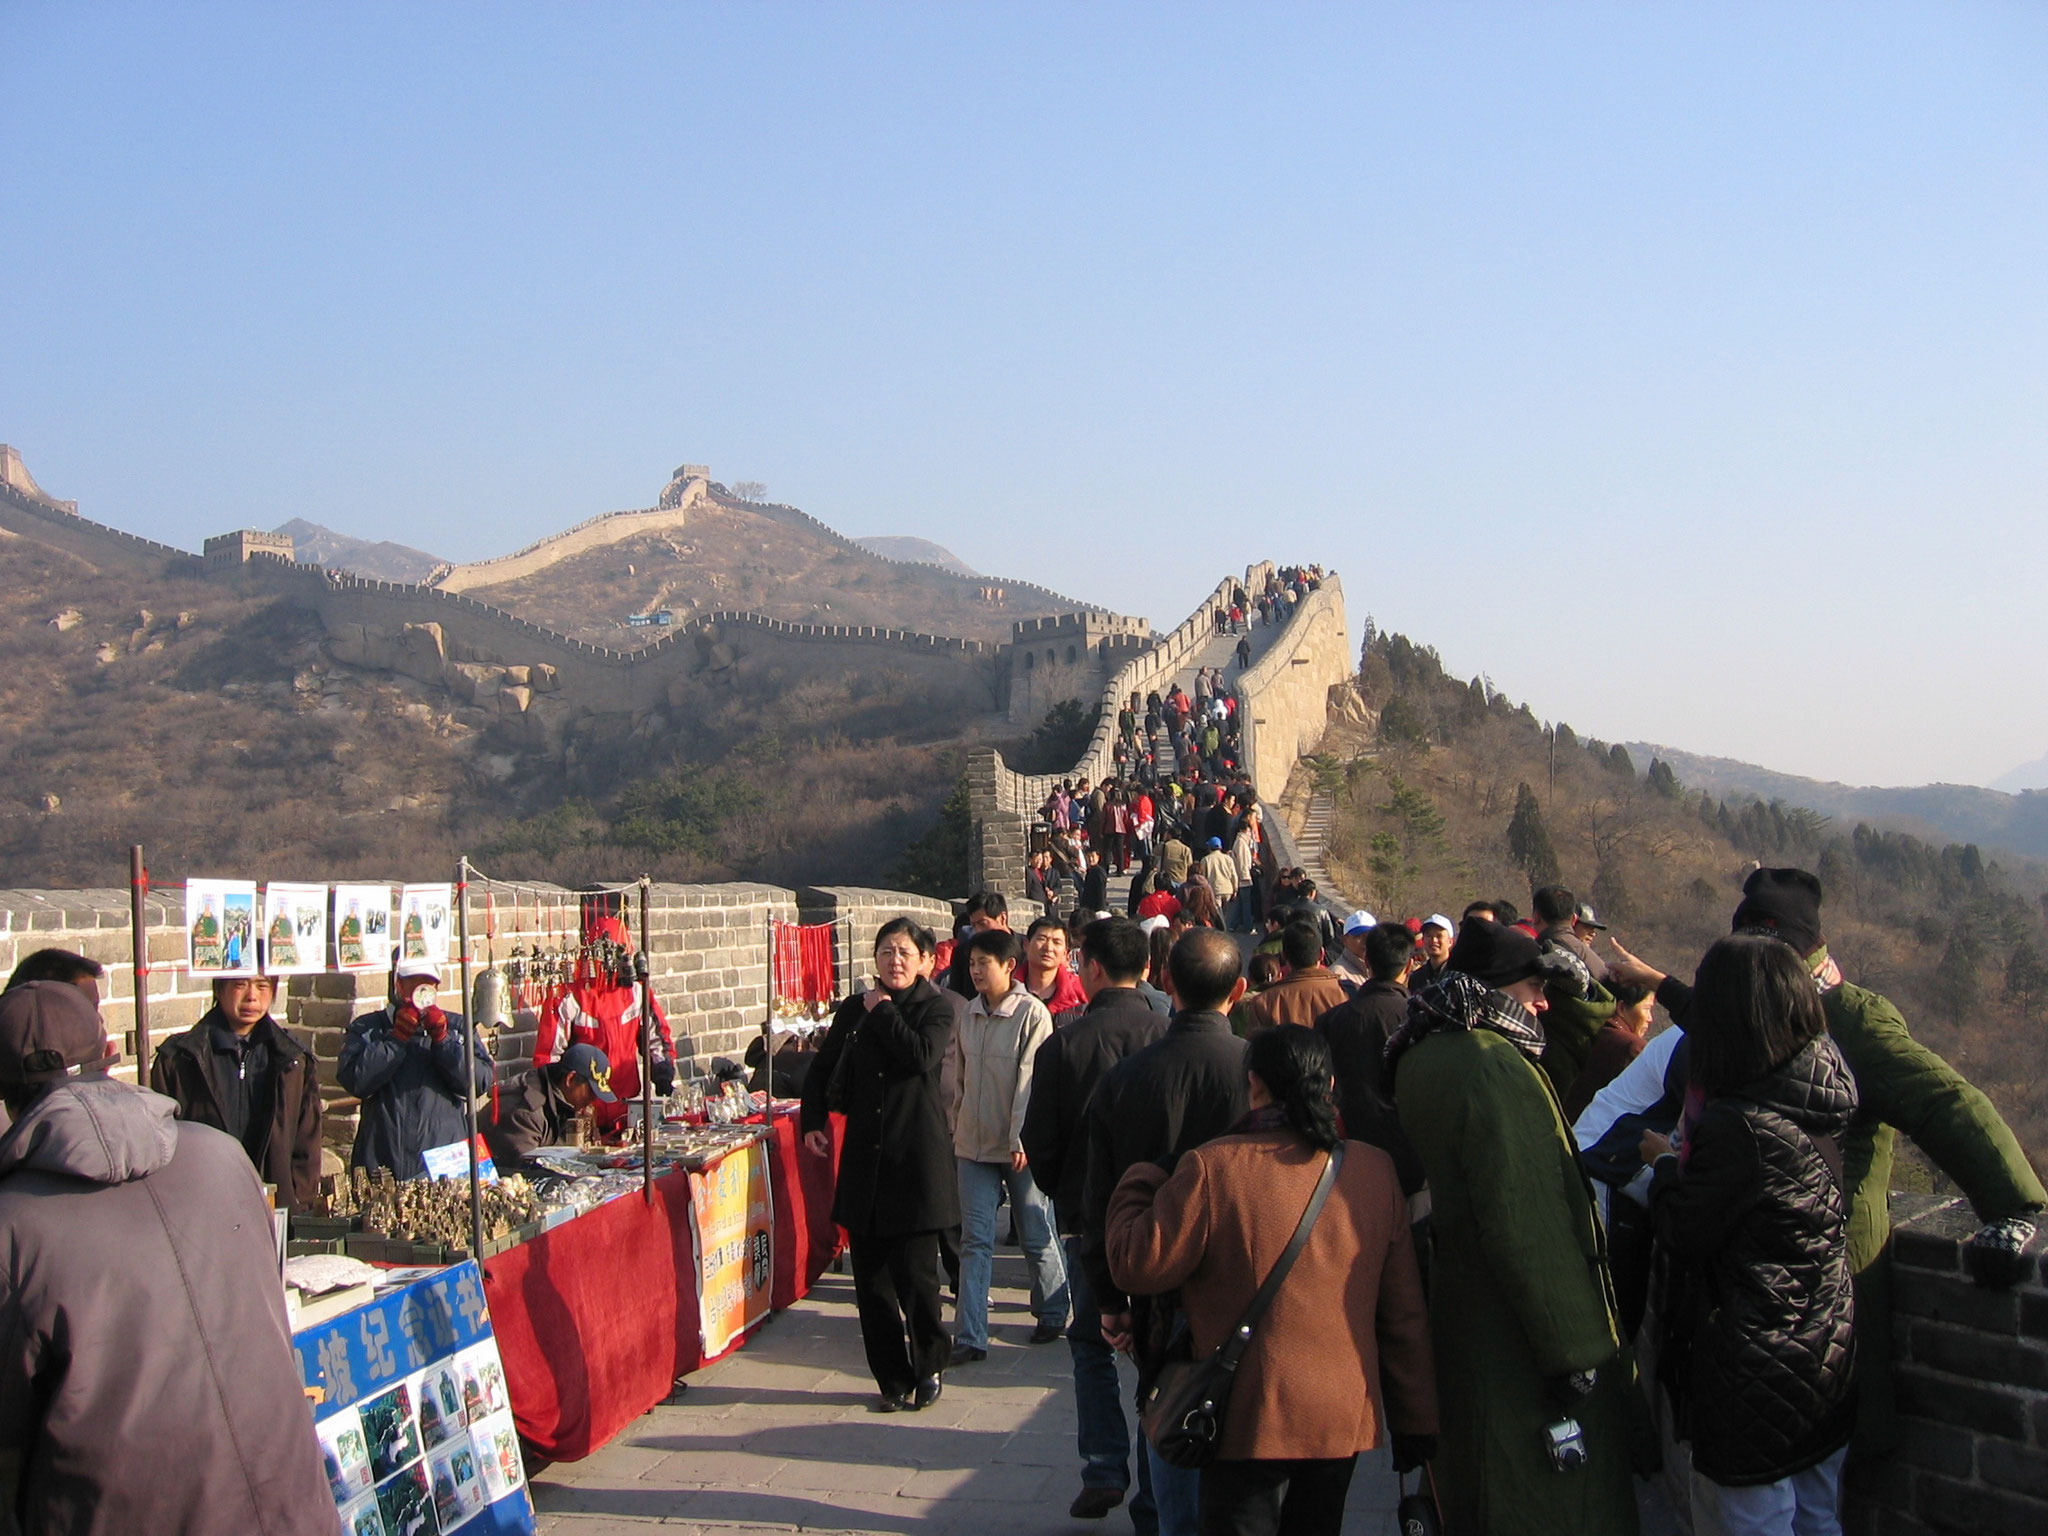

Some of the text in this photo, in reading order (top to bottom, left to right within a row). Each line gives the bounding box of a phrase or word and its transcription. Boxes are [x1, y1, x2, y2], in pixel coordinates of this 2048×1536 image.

[294, 1265, 483, 1418] 坡纪念证书
